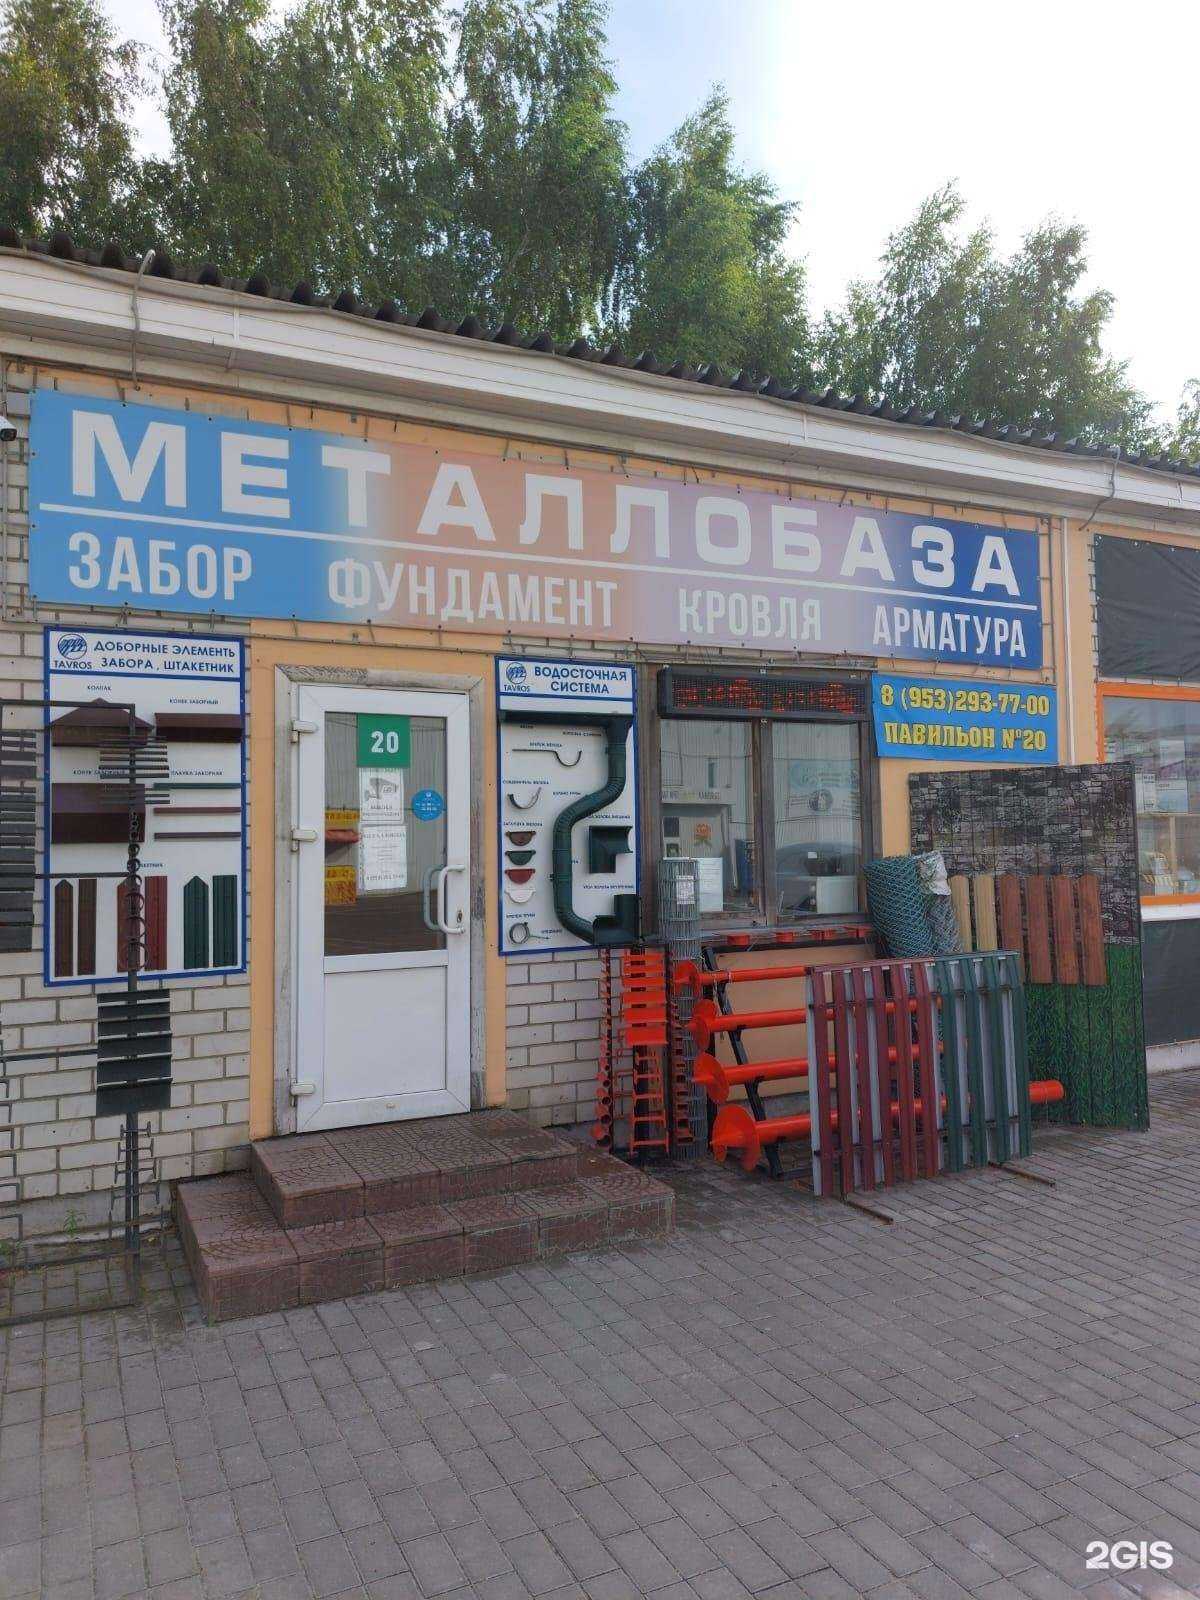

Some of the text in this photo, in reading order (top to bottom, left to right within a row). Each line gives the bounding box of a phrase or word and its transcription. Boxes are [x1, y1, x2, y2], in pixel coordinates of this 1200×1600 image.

[72, 410, 1021, 596] МЕТАЛЛОБАЗА
[68, 531, 252, 600] ЗАБОР
[328, 556, 617, 627] ФУНДАМЕНТ
[679, 587, 821, 640] КРОВЛЯ
[872, 604, 1026, 658] АРМАТУРА
[93, 640, 168, 654] ДОБОРНЫЕ
[54, 660, 92, 669] TAVROS
[164, 660, 234, 673] ШТАКЕТНИК
[534, 666, 627, 681] ВОДОСТОЧНАЯ
[503, 684, 530, 692] TAVROS
[550, 681, 609, 694] СИСТЕМА
[880, 684, 894, 706] 8
[901, 686, 1050, 717] (953)293-77-00
[371, 730, 399, 754] 20
[884, 722, 995, 748] ПАВИЛЬОН
